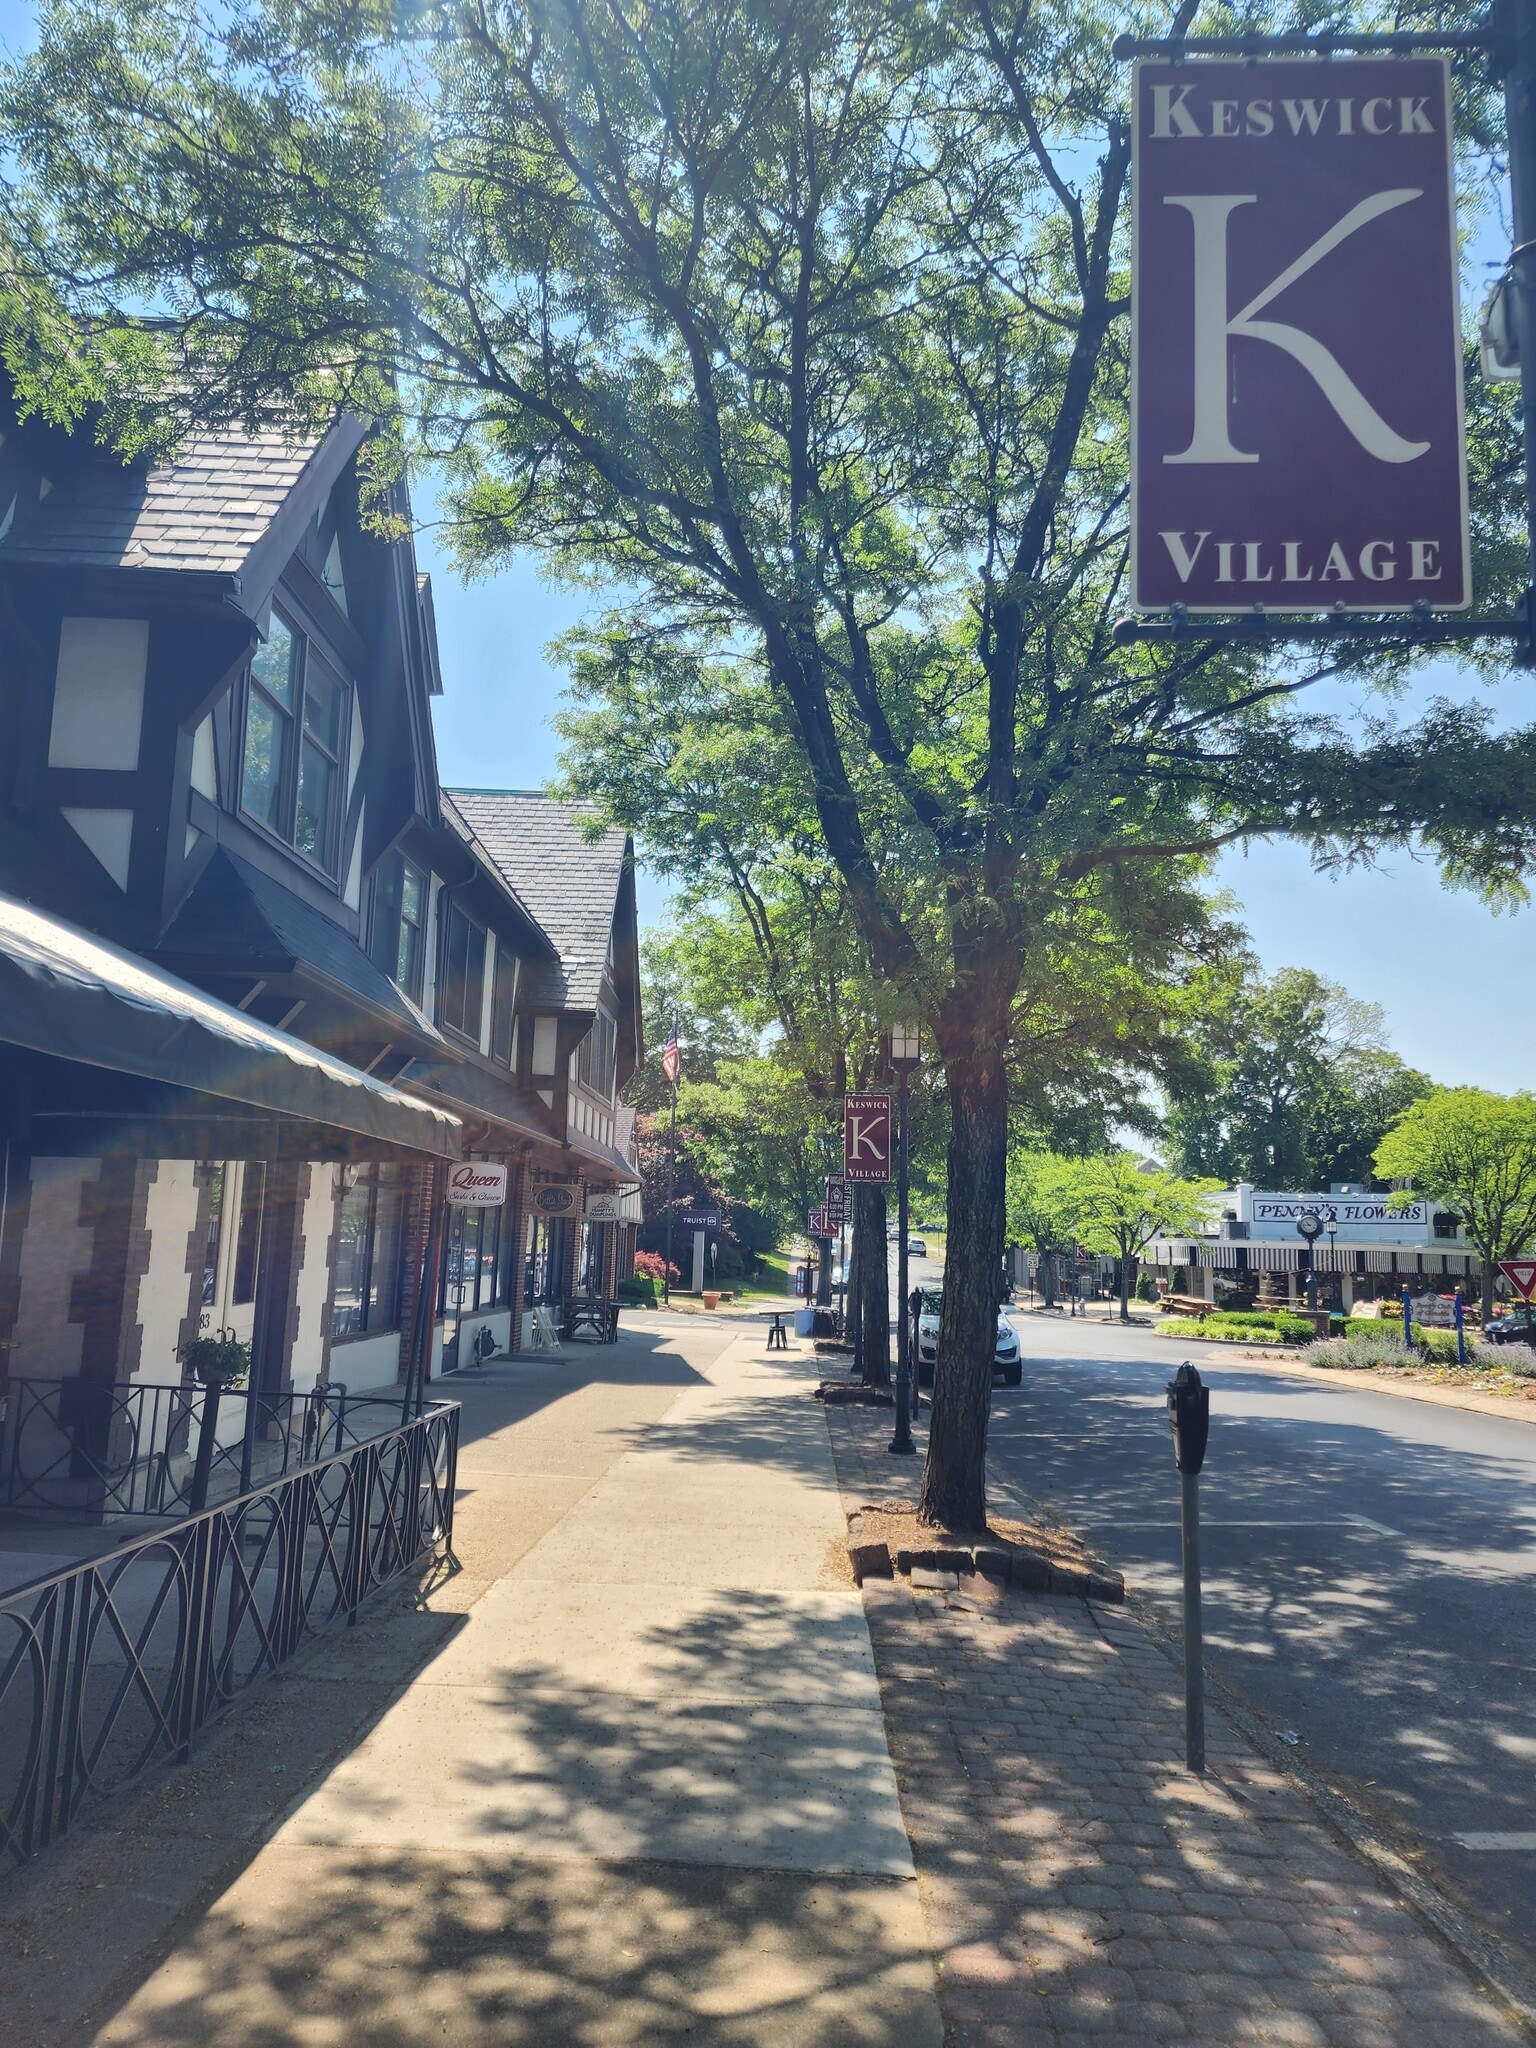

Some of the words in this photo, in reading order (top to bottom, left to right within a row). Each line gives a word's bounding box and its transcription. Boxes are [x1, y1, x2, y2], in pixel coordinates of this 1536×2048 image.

[1149, 84, 1436, 138] KESWICK
[1162, 188, 1431, 464] K
[1157, 531, 1442, 583] VILLAGE
[847, 1099, 888, 1109] KESWICK
[848, 1116, 886, 1160] K
[452, 1167, 502, 1190] Queen
[848, 1168, 887, 1178] VILLAGE
[469, 1193, 477, 1201] &
[810, 1215, 820, 1229] K
